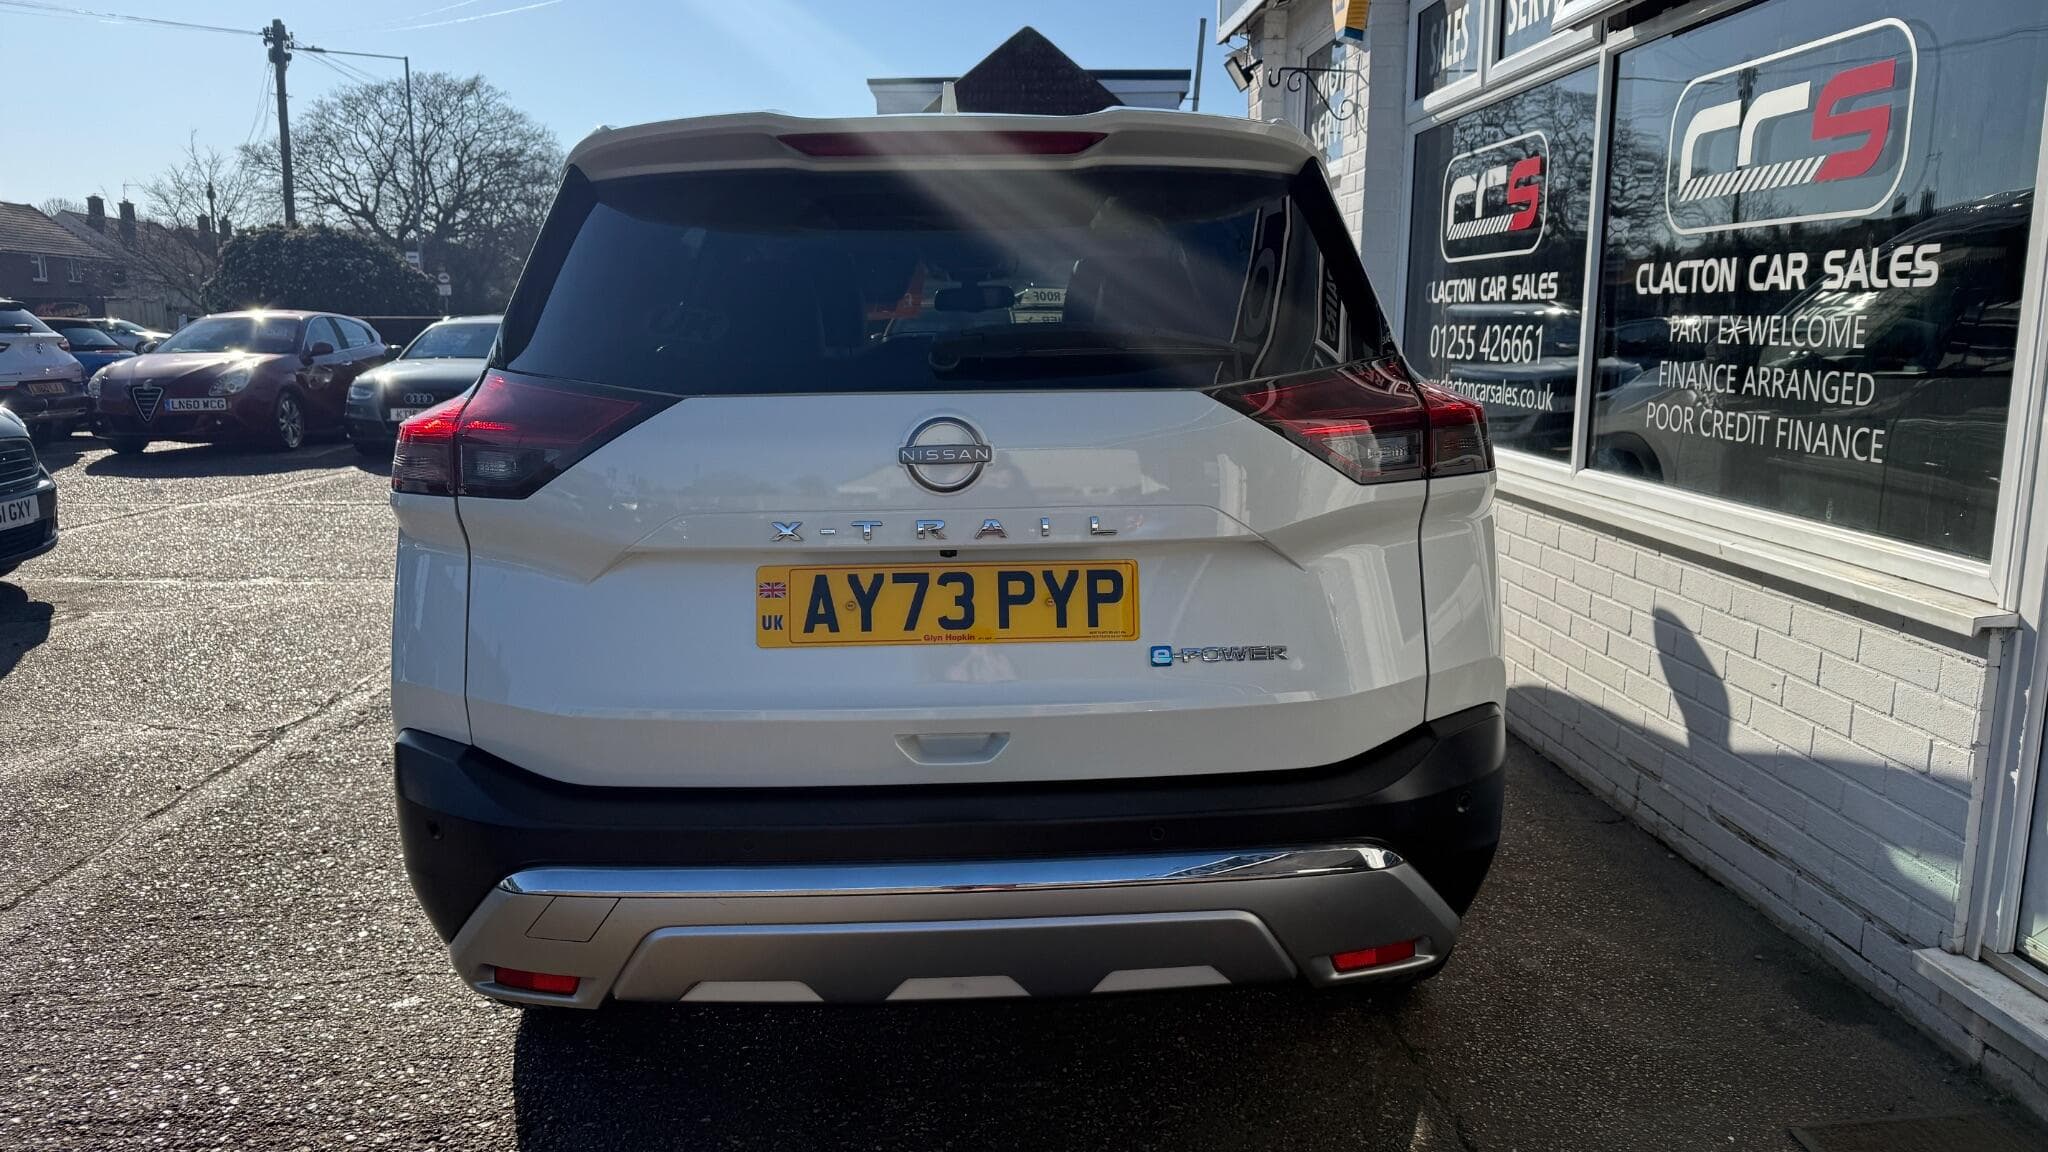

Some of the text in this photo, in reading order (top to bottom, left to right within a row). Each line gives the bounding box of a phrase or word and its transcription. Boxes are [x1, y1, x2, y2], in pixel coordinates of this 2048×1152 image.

[1430, 3, 1469, 76] SALES
[1636, 243, 1942, 295] CLACTON CAR SALES
[1426, 271, 1559, 303] CLACTON CAR SALES
[1430, 324, 1544, 364] 01255 426661
[1669, 315, 1710, 344] PART
[1748, 315, 1867, 349] WELCOME
[1658, 360, 1875, 407] FINANCE ARRANGED
[1646, 402, 1886, 464] POOR CREDIT FINANCE
[901, 447, 989, 461] NISSAN
[9, 500, 31, 521] GXY
[770, 516, 1118, 541] X-TRAIL
[802, 568, 1124, 634] AY73 PYP
[761, 614, 784, 631] UK
[923, 634, 943, 643] Glyn
[945, 633, 976, 641] Hopkin
